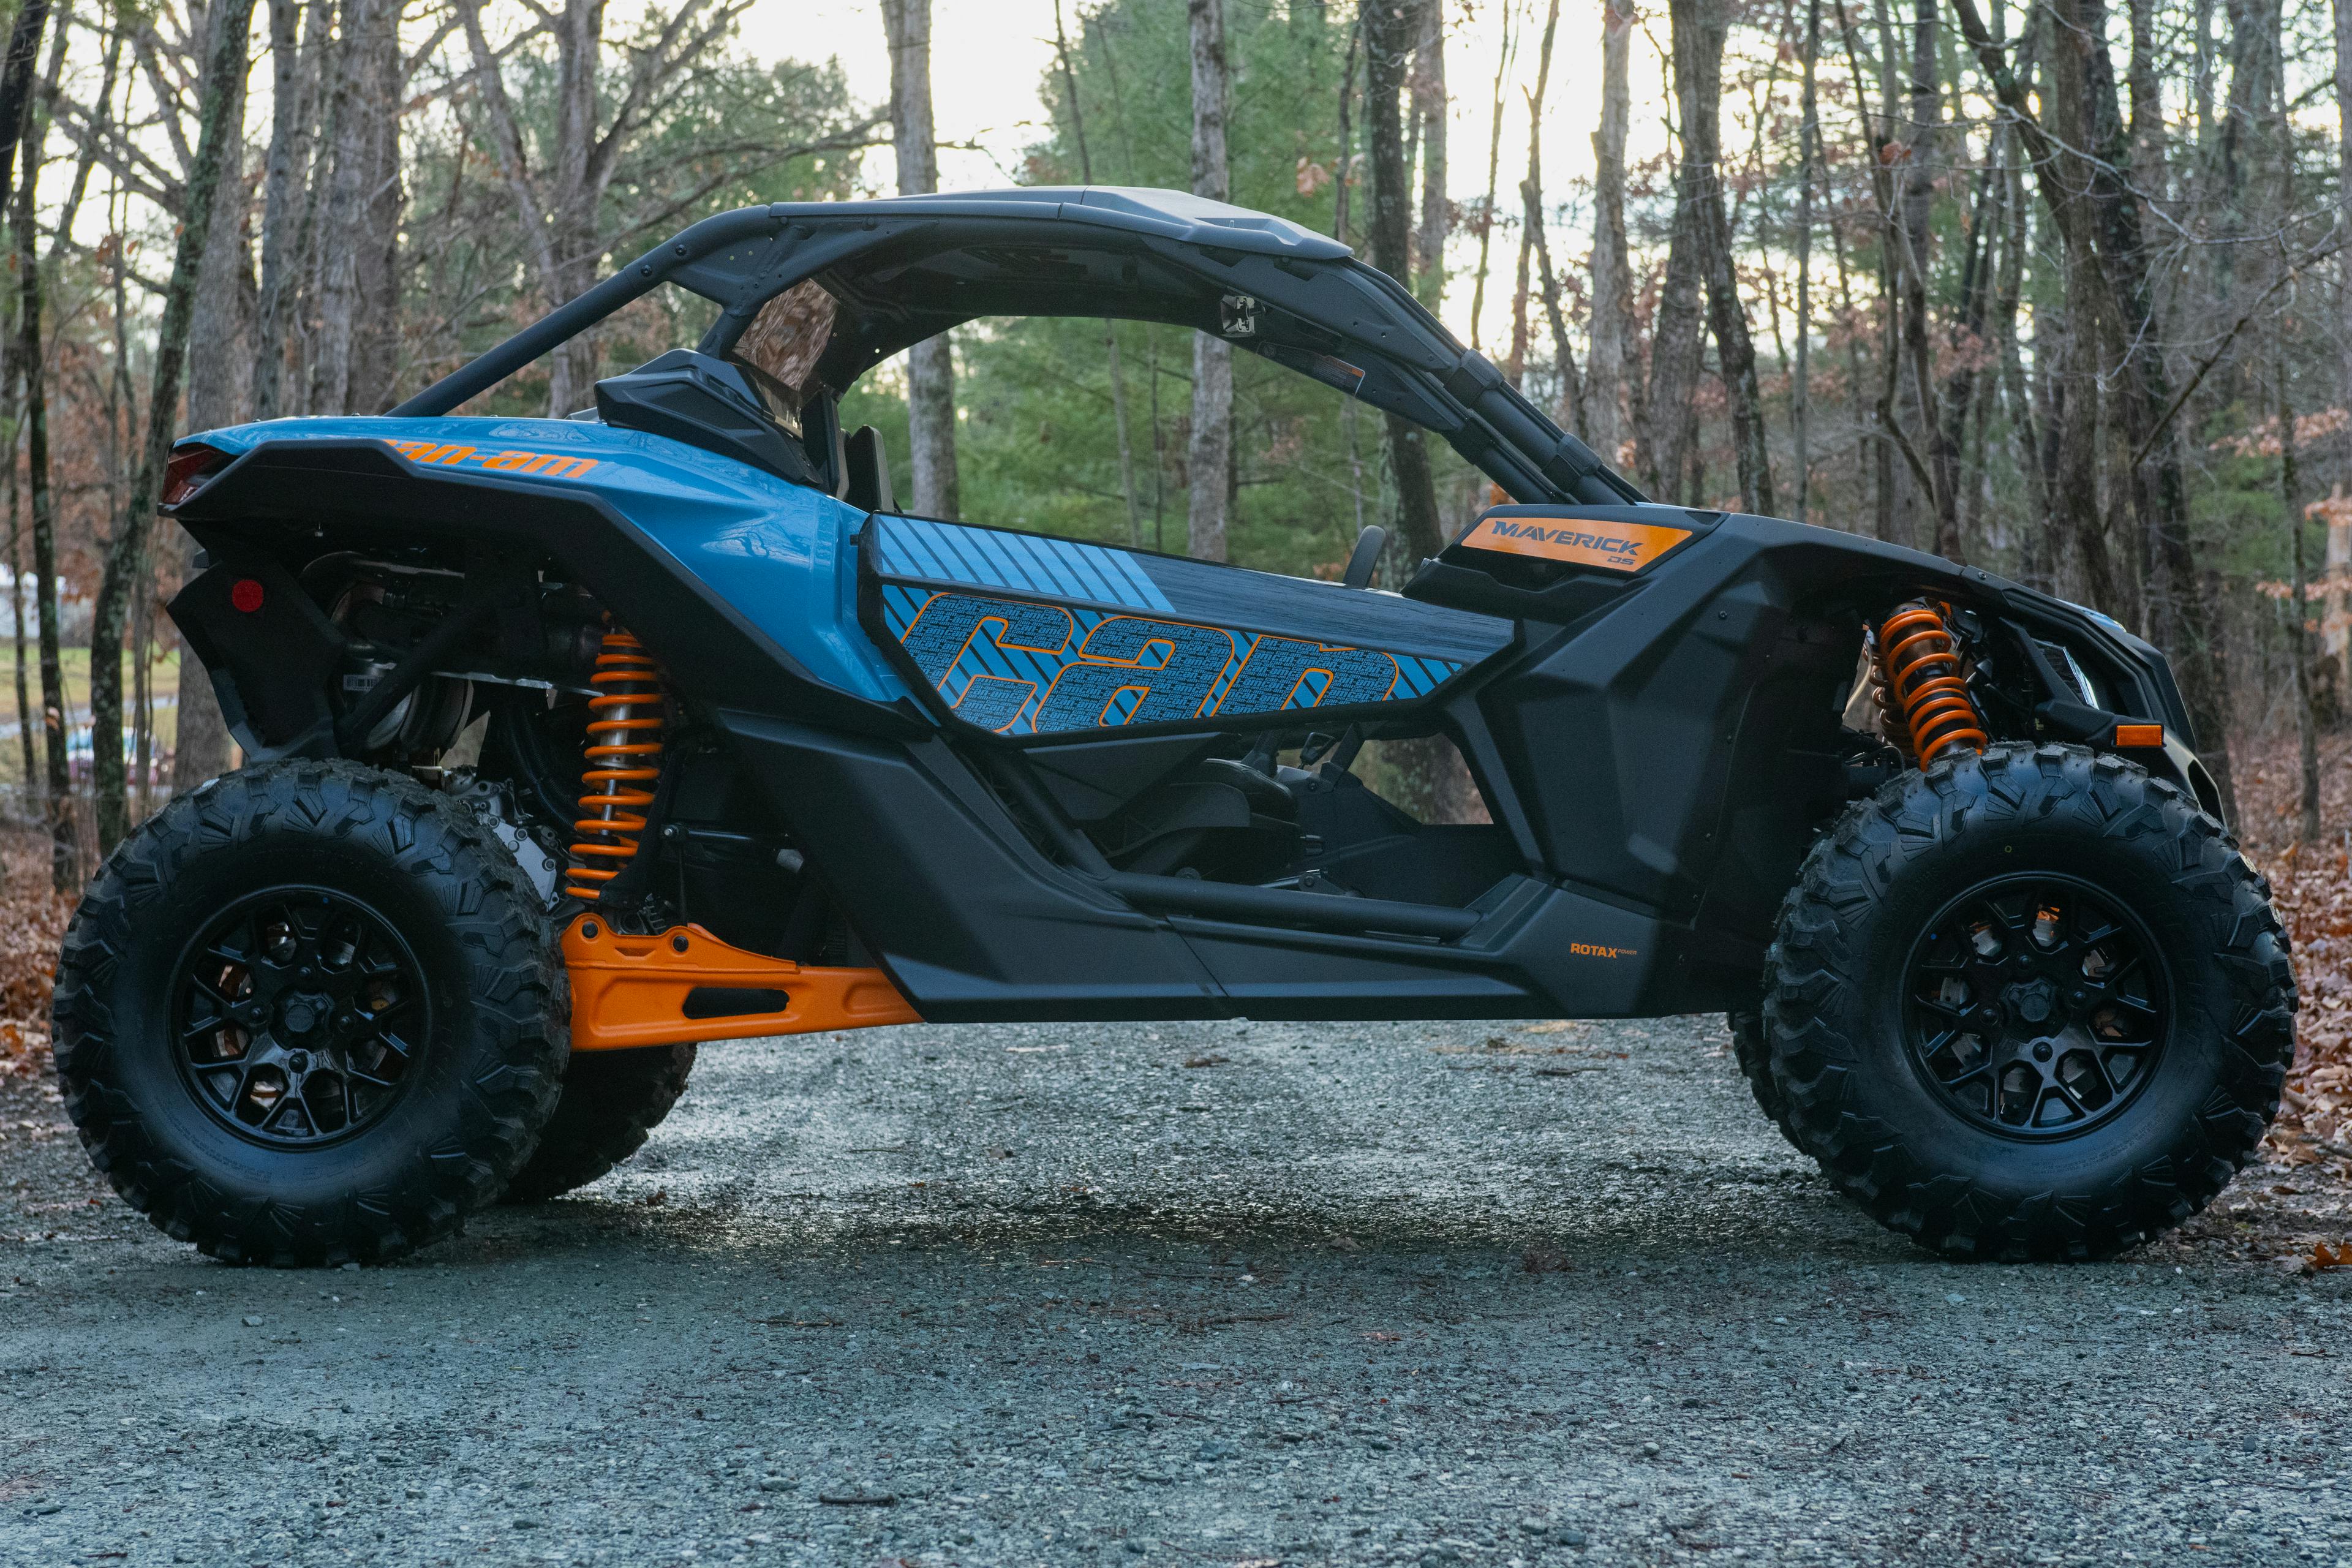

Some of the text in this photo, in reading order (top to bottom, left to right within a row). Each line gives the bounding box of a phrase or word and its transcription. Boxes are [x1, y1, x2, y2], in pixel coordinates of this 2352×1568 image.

[382, 439, 598, 478] an-am
[1491, 521, 1645, 556] MAVERICK
[1570, 943, 1618, 959] ROTAX
